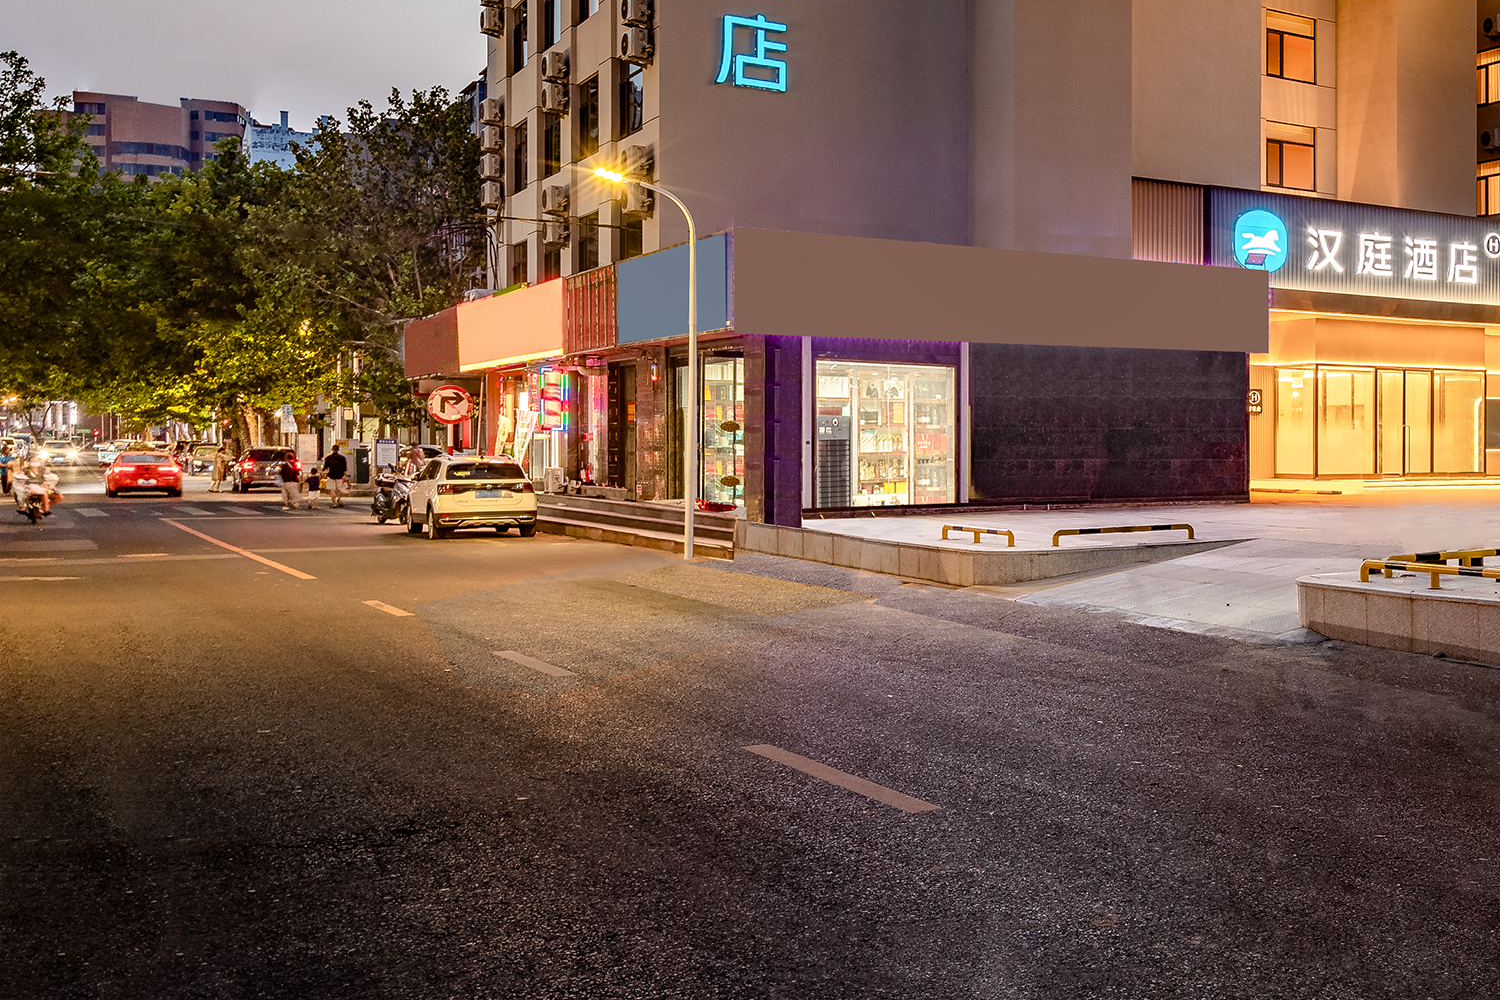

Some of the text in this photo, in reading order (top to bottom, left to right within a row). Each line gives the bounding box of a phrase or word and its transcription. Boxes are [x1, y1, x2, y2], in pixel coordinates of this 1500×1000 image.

[1305, 226, 1479, 285] 汉庭酒店
[1486, 235, 1500, 256] H
